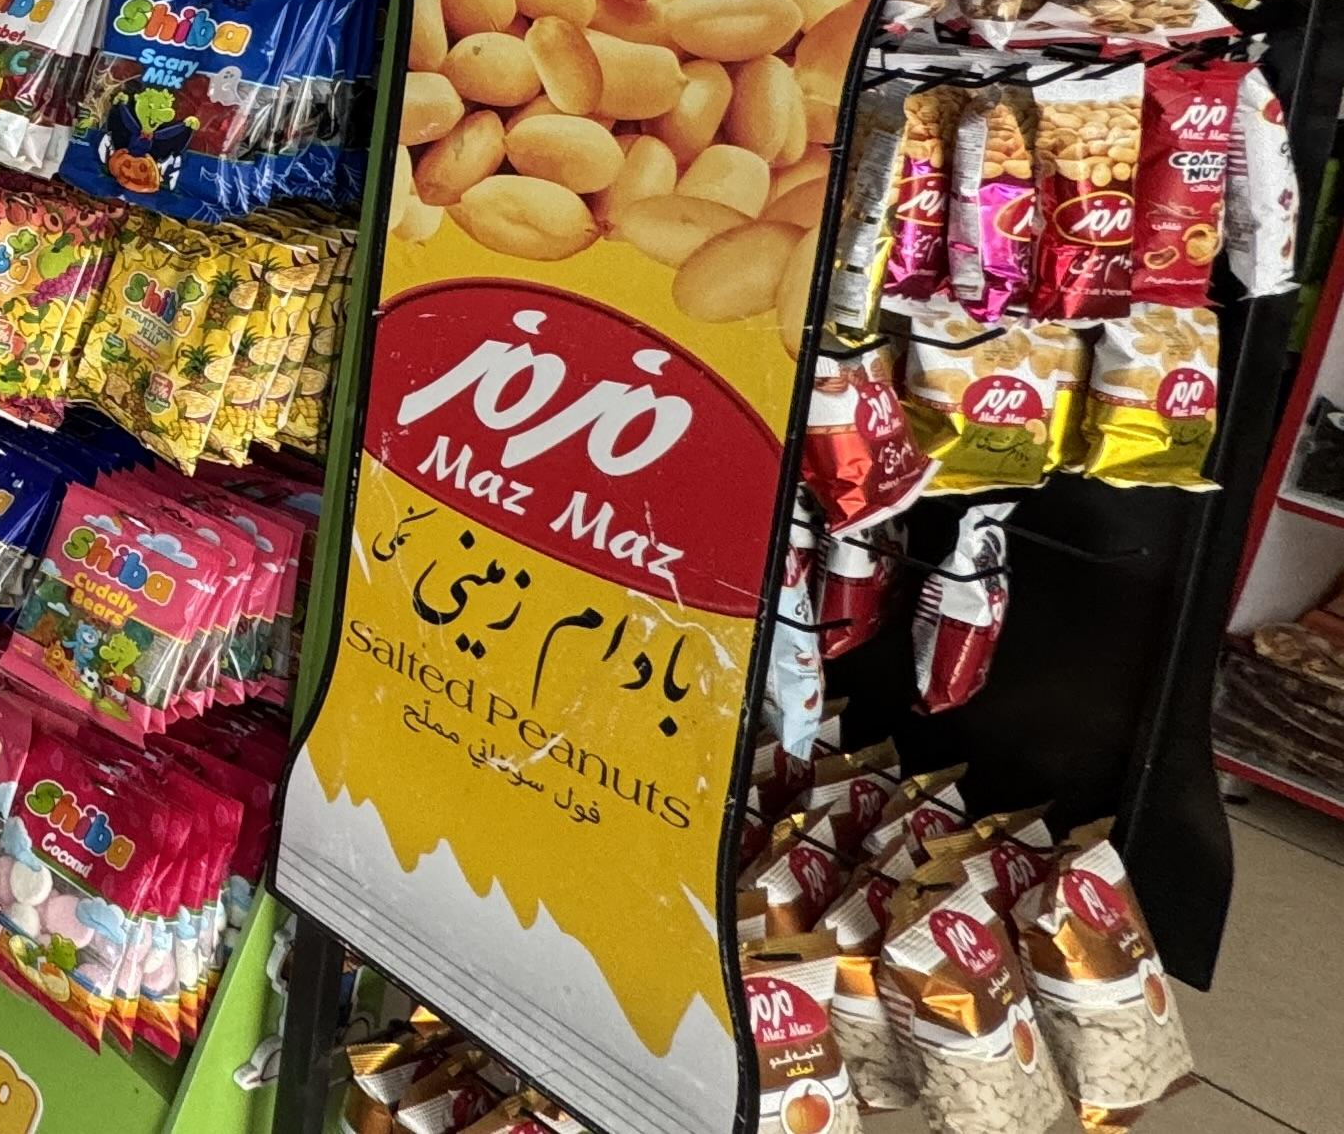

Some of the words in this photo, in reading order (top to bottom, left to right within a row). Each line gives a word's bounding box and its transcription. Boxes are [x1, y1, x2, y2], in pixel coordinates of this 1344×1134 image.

[137, 49, 201, 76] Scary
[143, 66, 182, 90] Mix
[1171, 97, 1229, 130] مزمز
[1184, 166, 1221, 183] NUT
[397, 309, 695, 477] مزمز
[973, 380, 1030, 414] مزمز
[416, 435, 538, 517] Maz
[549, 493, 686, 581] Maz
[61, 523, 178, 608] Shiba
[70, 586, 127, 629] Bears
[72, 571, 140, 618] Cuddly
[412, 531, 532, 660] زمینی
[532, 606, 692, 738] بادام
[345, 619, 476, 716] Salted
[485, 693, 692, 830] Peanuts
[24, 779, 136, 872] Shiba
[551, 786, 602, 825] فول
[40, 831, 95, 878] Coconut
[762, 1026, 787, 1043] Maz
[788, 1023, 813, 1039] Maz
